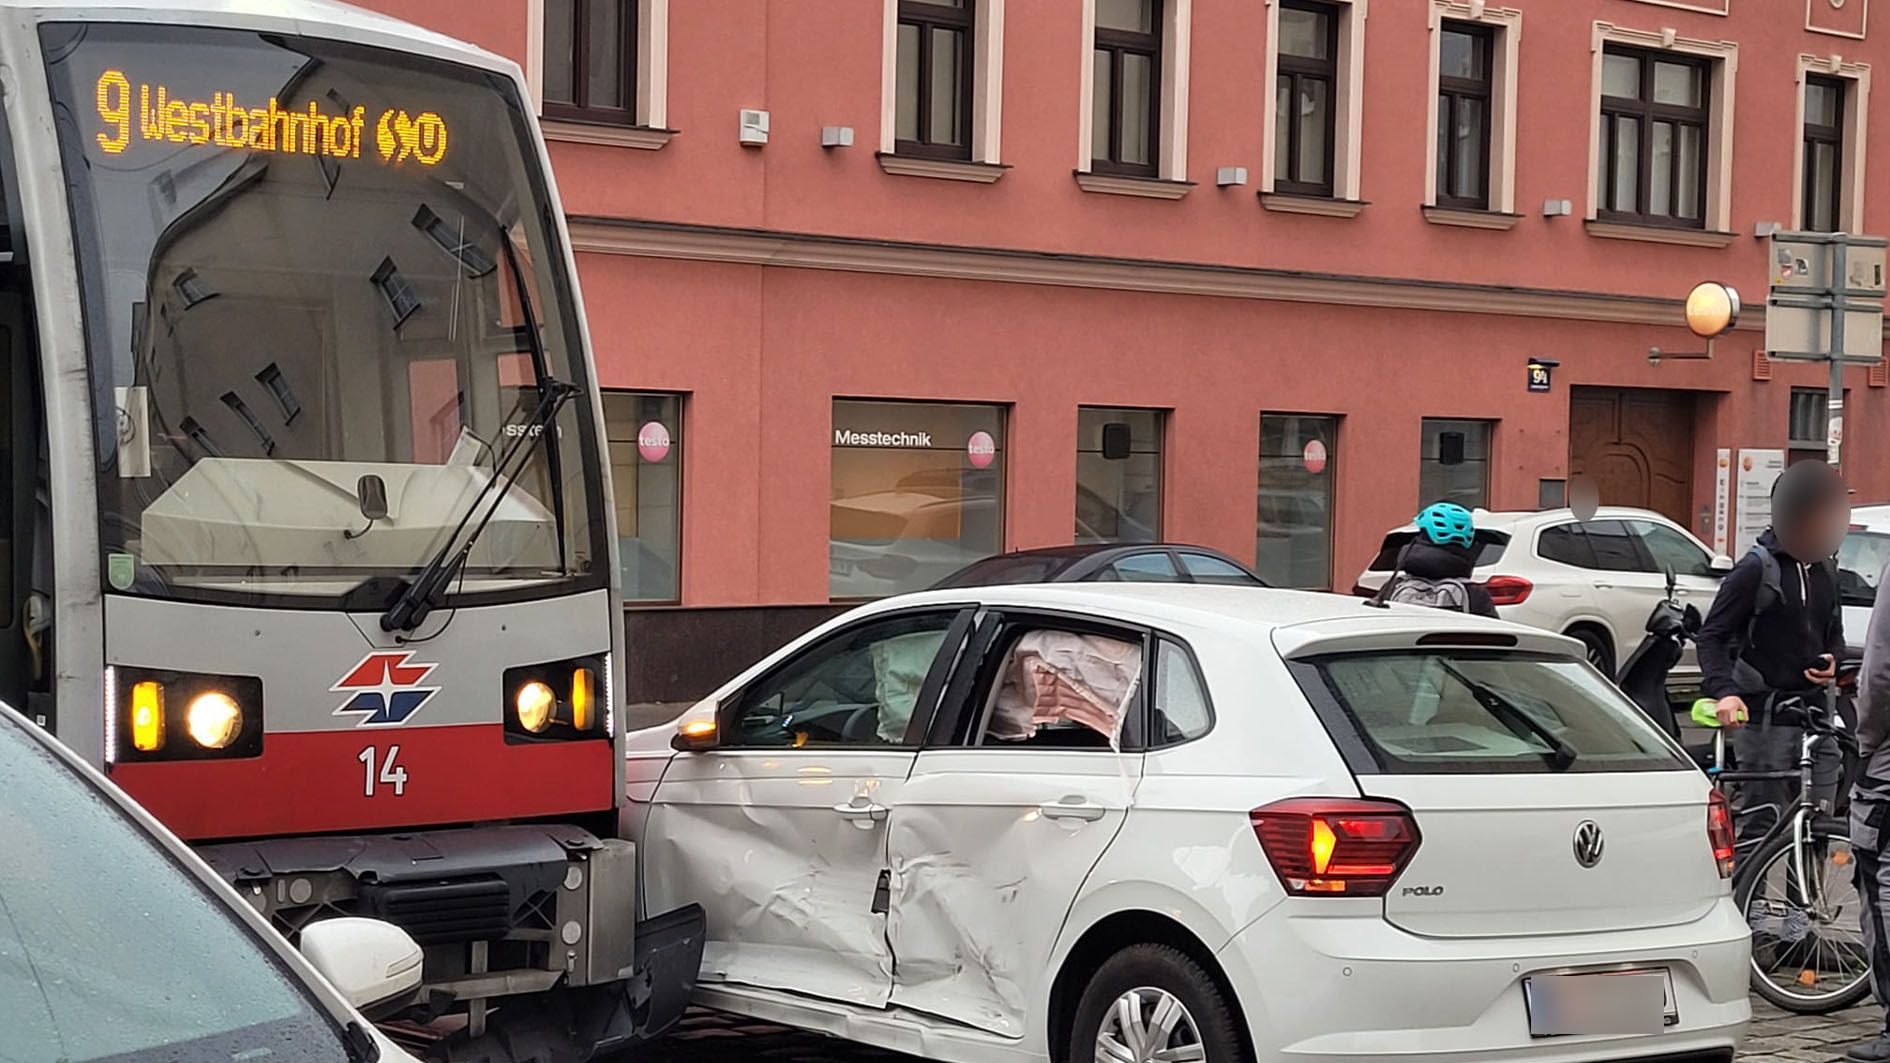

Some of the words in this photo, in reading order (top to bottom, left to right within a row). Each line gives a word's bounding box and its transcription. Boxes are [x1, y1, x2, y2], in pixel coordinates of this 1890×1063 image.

[96, 70, 130, 153] 9
[140, 84, 366, 158] Westbahnhof
[1533, 370, 1548, 384] 94
[639, 437, 670, 447] testo
[835, 430, 931, 446] Messtechnik
[358, 746, 408, 795] 14
[1402, 886, 1444, 896] POLO
